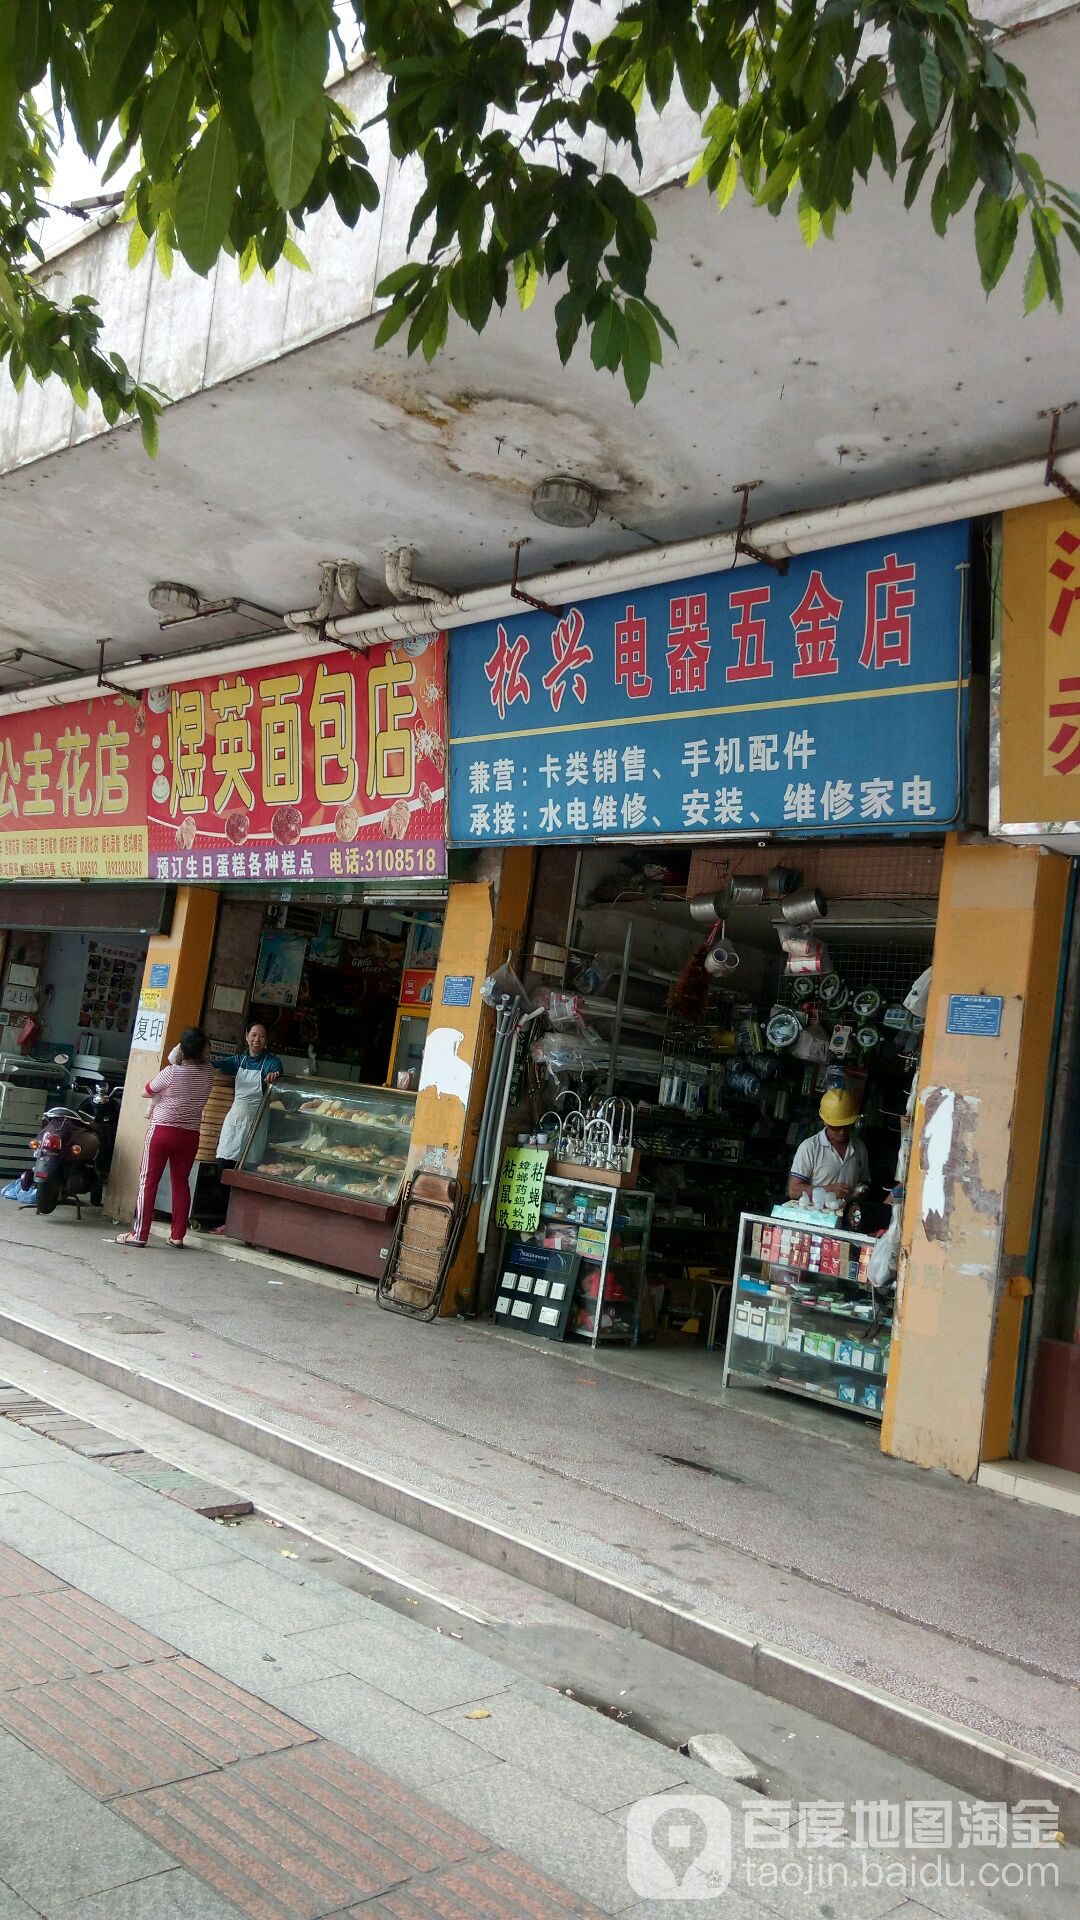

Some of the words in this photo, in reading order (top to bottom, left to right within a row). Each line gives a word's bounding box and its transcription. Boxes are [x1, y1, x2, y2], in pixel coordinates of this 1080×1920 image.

[484, 553, 916, 720] 松兴电器五金店
[0, 720, 130, 818] 公主花店
[168, 650, 418, 818] 煜英面包店
[156, 849, 314, 878] 预订生日蛋糕各种糕点
[330, 847, 437, 875] 电话:3108518
[134, 1016, 165, 1042] 复印
[497, 1159, 517, 1228] 粘鼠胶
